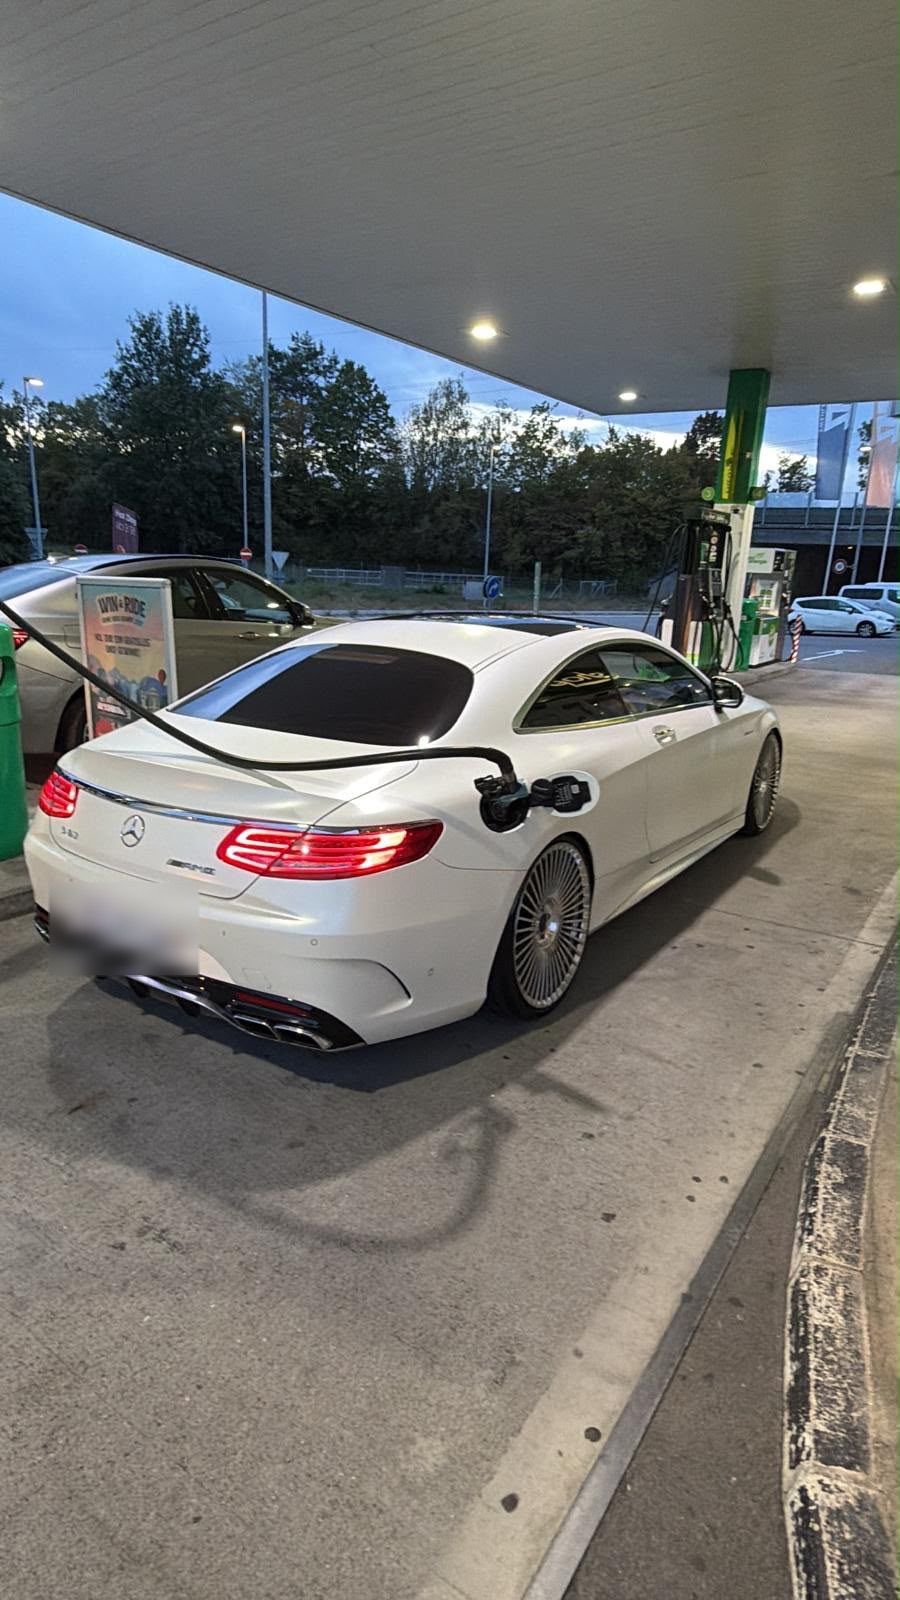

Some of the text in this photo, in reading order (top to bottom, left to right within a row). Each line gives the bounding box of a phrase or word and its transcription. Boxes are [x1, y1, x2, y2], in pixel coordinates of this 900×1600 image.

[97, 595, 119, 614] WIN
[124, 595, 146, 618] RIDE
[61, 825, 67, 834] S
[178, 861, 217, 876] AMG
